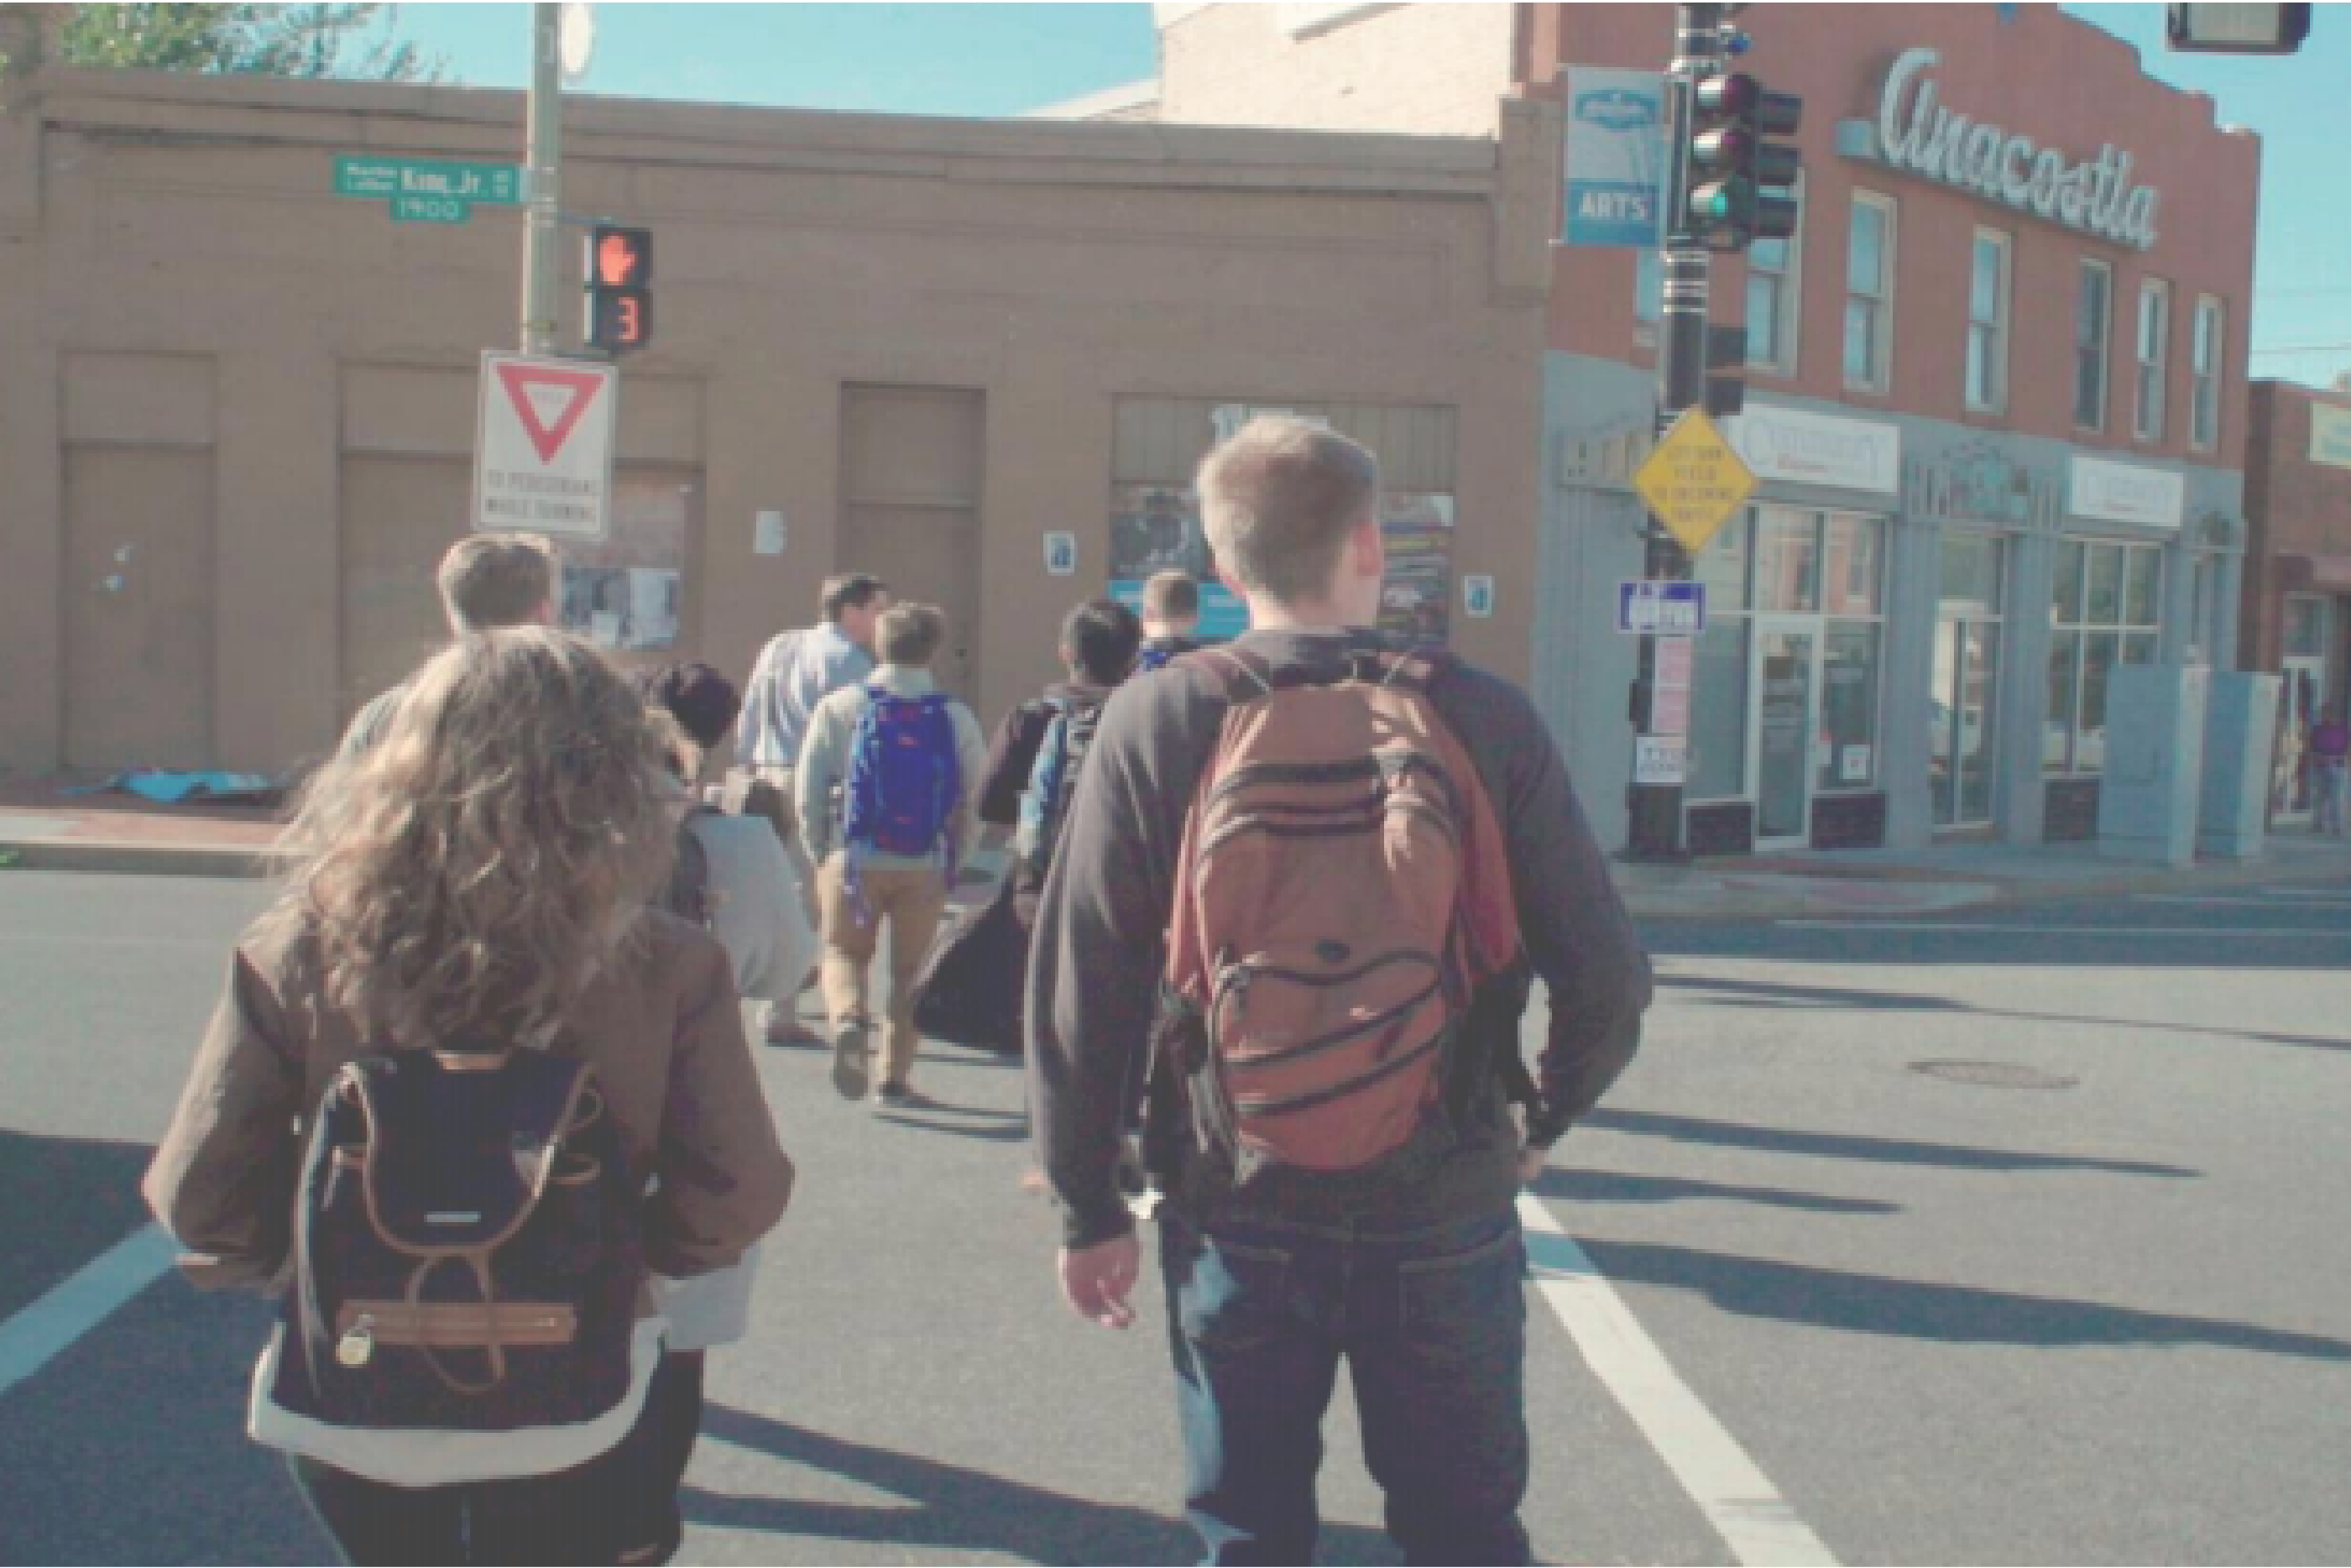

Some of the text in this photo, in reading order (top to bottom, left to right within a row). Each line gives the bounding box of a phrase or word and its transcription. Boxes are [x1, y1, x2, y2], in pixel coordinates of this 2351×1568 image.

[1879, 47, 2160, 251] Anacostia
[399, 199, 460, 221] 1900
[1579, 192, 1645, 220] ARTS
[618, 297, 639, 342] 3
